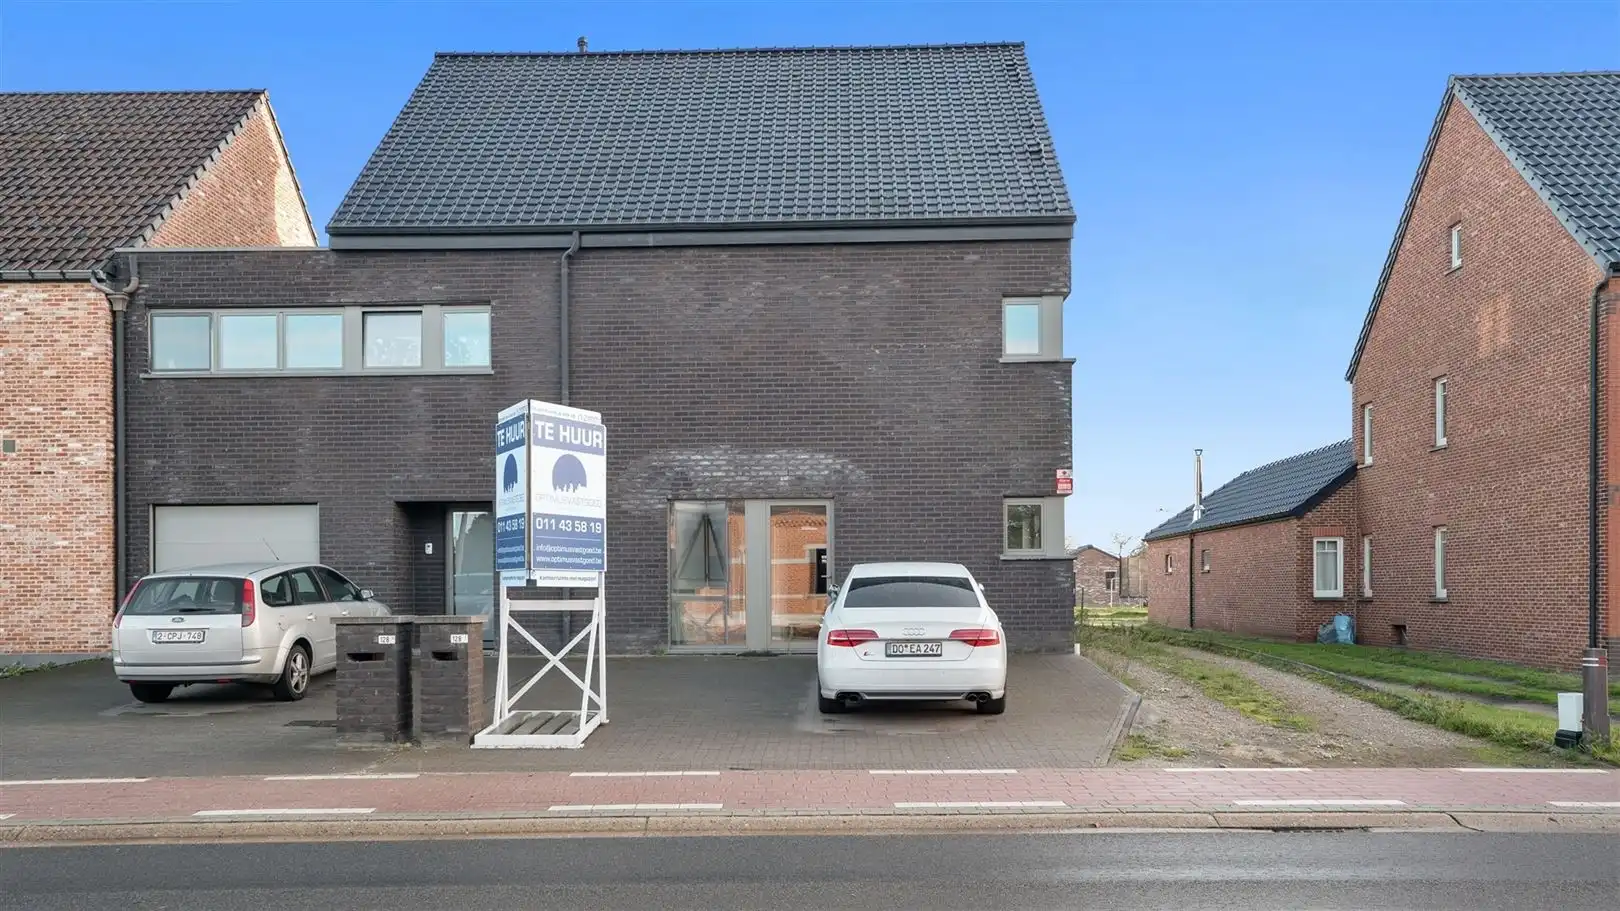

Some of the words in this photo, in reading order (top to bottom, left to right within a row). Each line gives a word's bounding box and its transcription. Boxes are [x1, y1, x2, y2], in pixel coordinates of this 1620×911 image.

[498, 428, 505, 447] TE
[506, 420, 525, 444] HUUR
[534, 420, 555, 440] TE
[559, 424, 603, 449] HUUR
[535, 517, 556, 530] 011
[559, 519, 573, 532] 43
[574, 520, 588, 533] 58
[589, 521, 602, 534] 19
[909, 644, 922, 653] EA
[923, 644, 940, 653] 247
